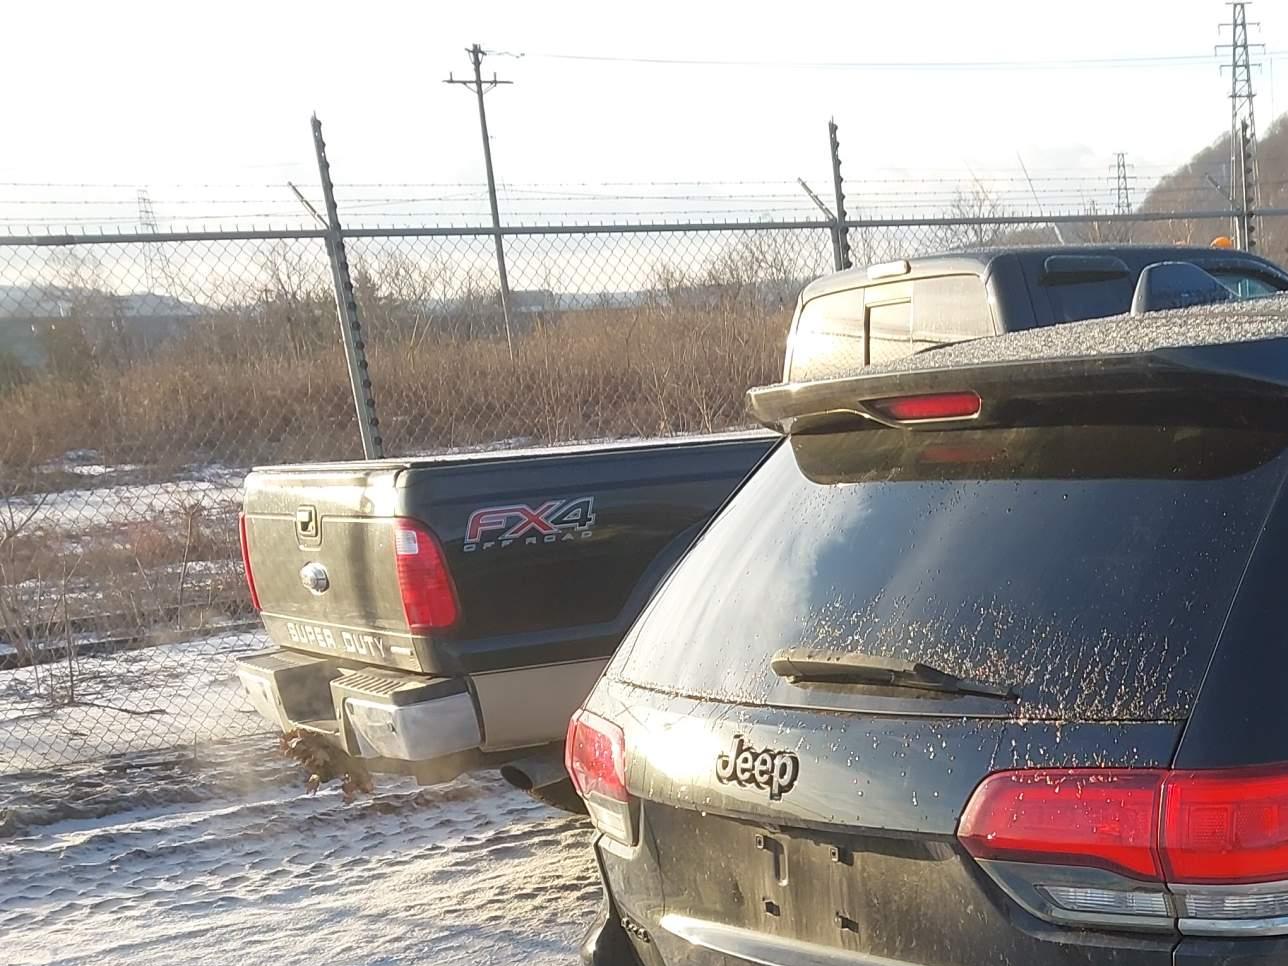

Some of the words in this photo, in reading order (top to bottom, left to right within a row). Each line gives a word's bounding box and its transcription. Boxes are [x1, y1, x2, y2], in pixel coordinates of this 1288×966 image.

[464, 496, 596, 543] FX4
[463, 539, 513, 552] OFF
[525, 530, 593, 545] ROAD
[287, 622, 337, 649] SUPER
[341, 631, 385, 658] DUTY
[716, 734, 800, 801] Jeep
